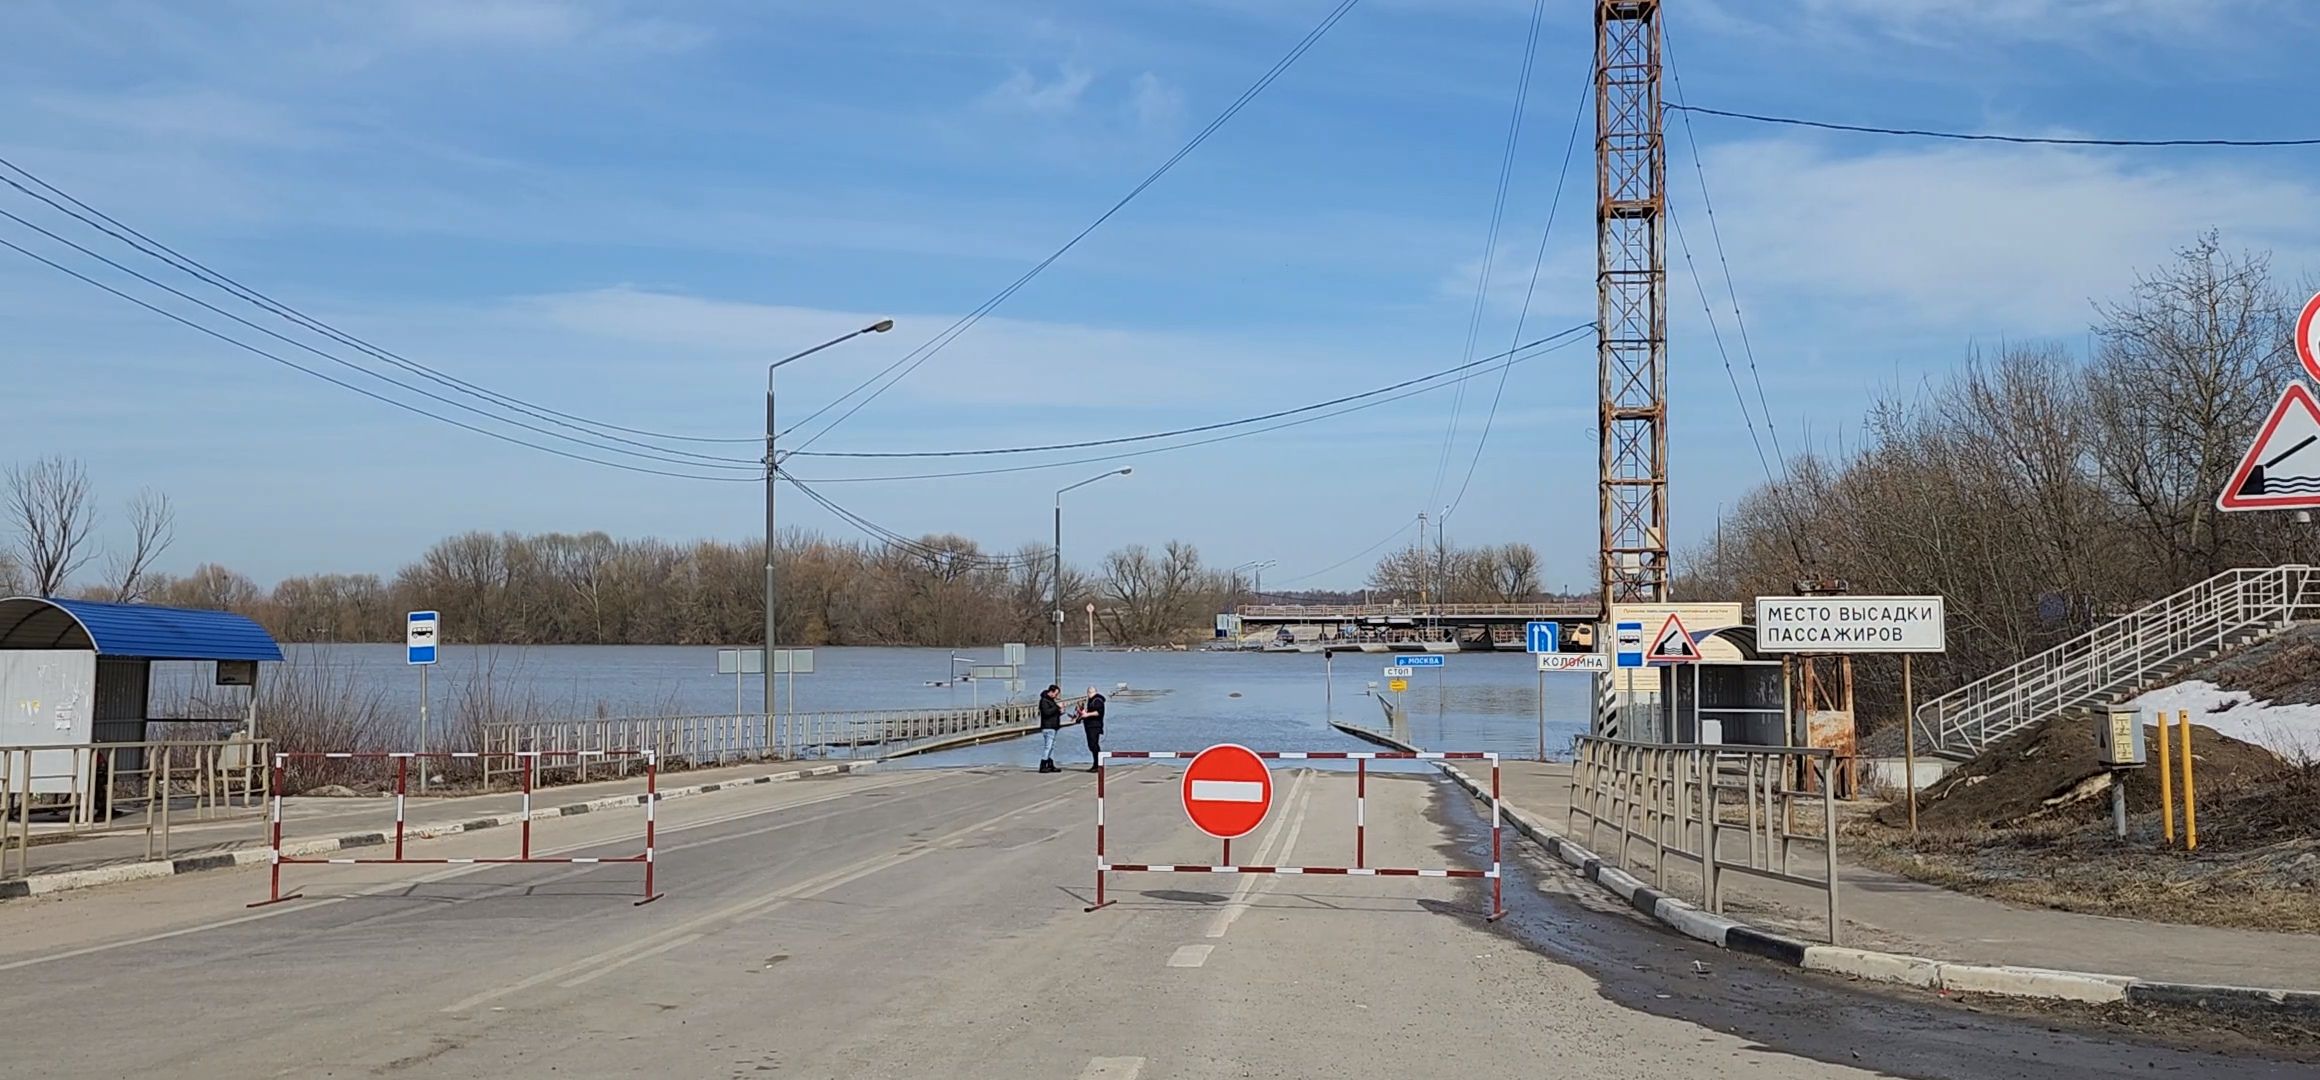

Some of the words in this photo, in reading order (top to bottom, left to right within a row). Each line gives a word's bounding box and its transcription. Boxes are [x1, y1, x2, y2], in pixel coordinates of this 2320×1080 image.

[1768, 607, 1831, 621] МЕСТО
[1839, 607, 1932, 623] ВЫСАДКИ
[1768, 627, 1903, 642] ПАССАЖИРОВ
[1543, 657, 1602, 667] КОЛОМНА
